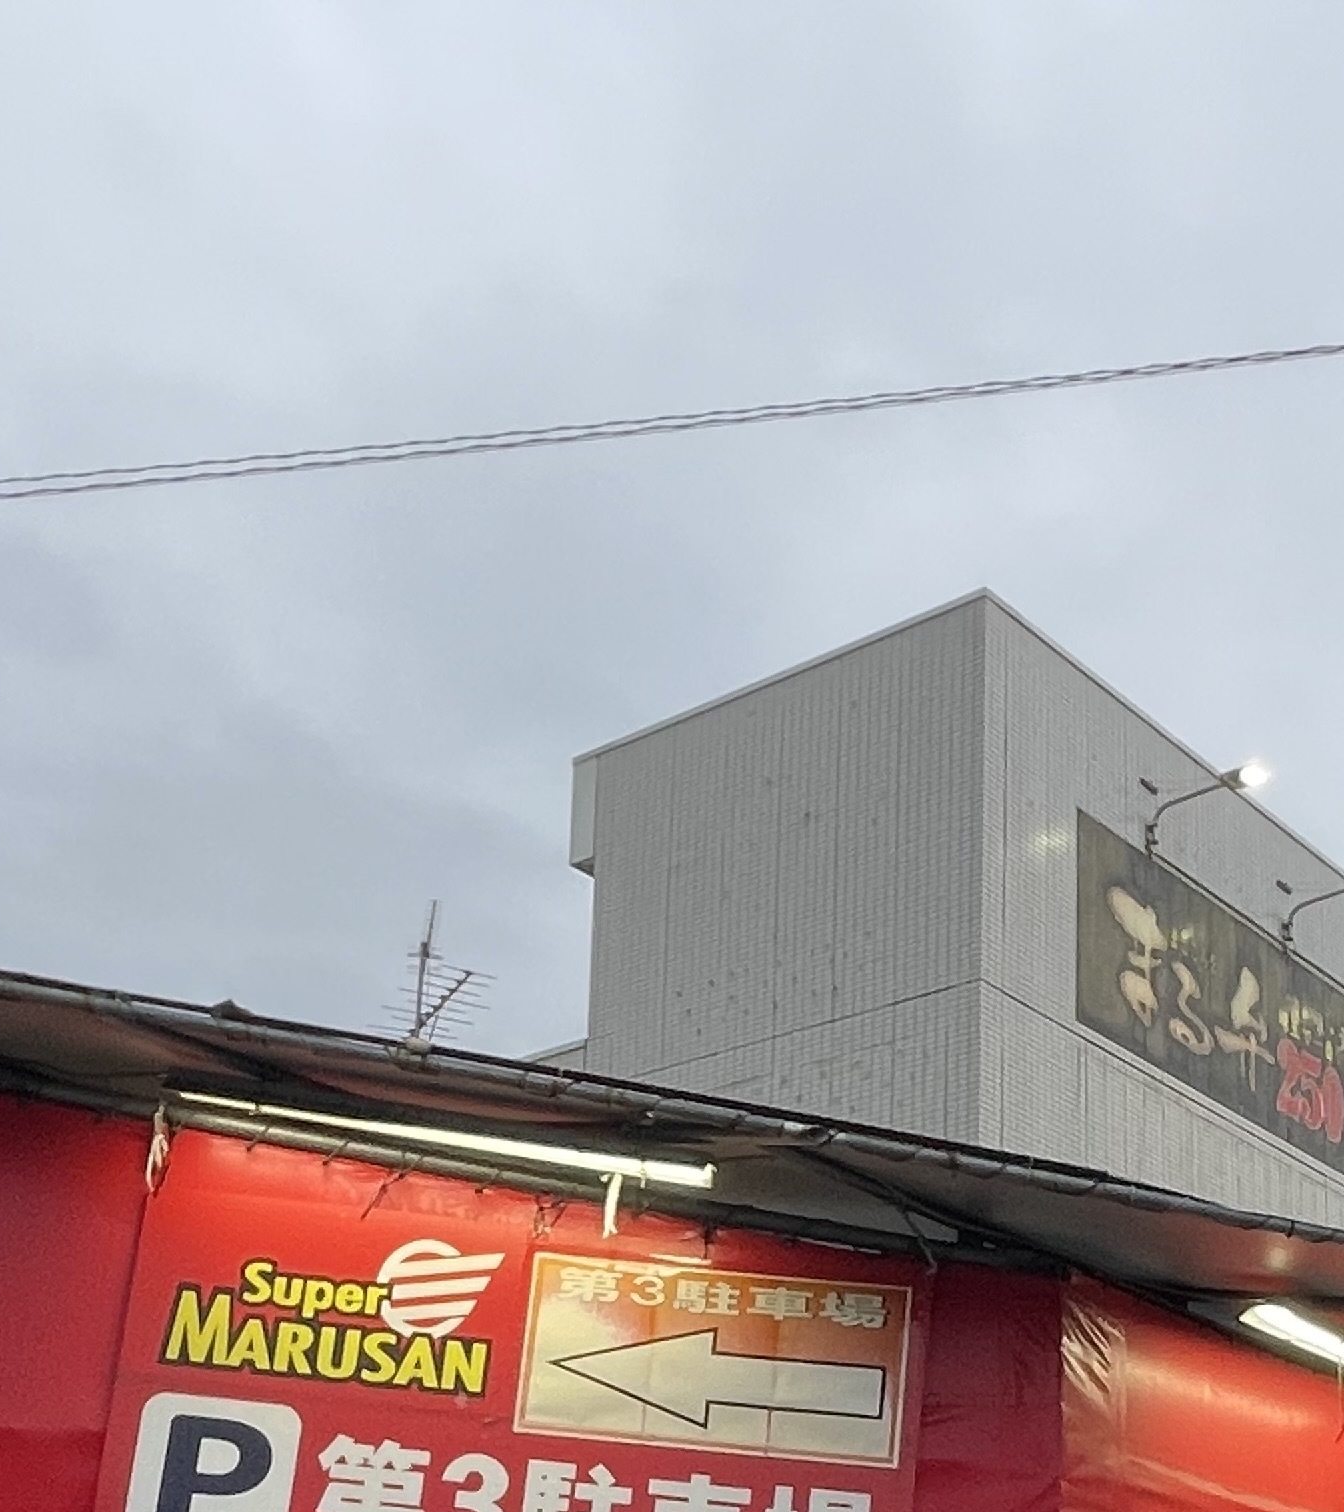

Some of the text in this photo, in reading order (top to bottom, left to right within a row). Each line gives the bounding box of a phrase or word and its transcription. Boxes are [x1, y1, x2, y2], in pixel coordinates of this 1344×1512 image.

[241, 1260, 390, 1319] Super
[558, 1266, 888, 1328] 第3駐車場
[164, 1288, 488, 1394] MARUSAN
